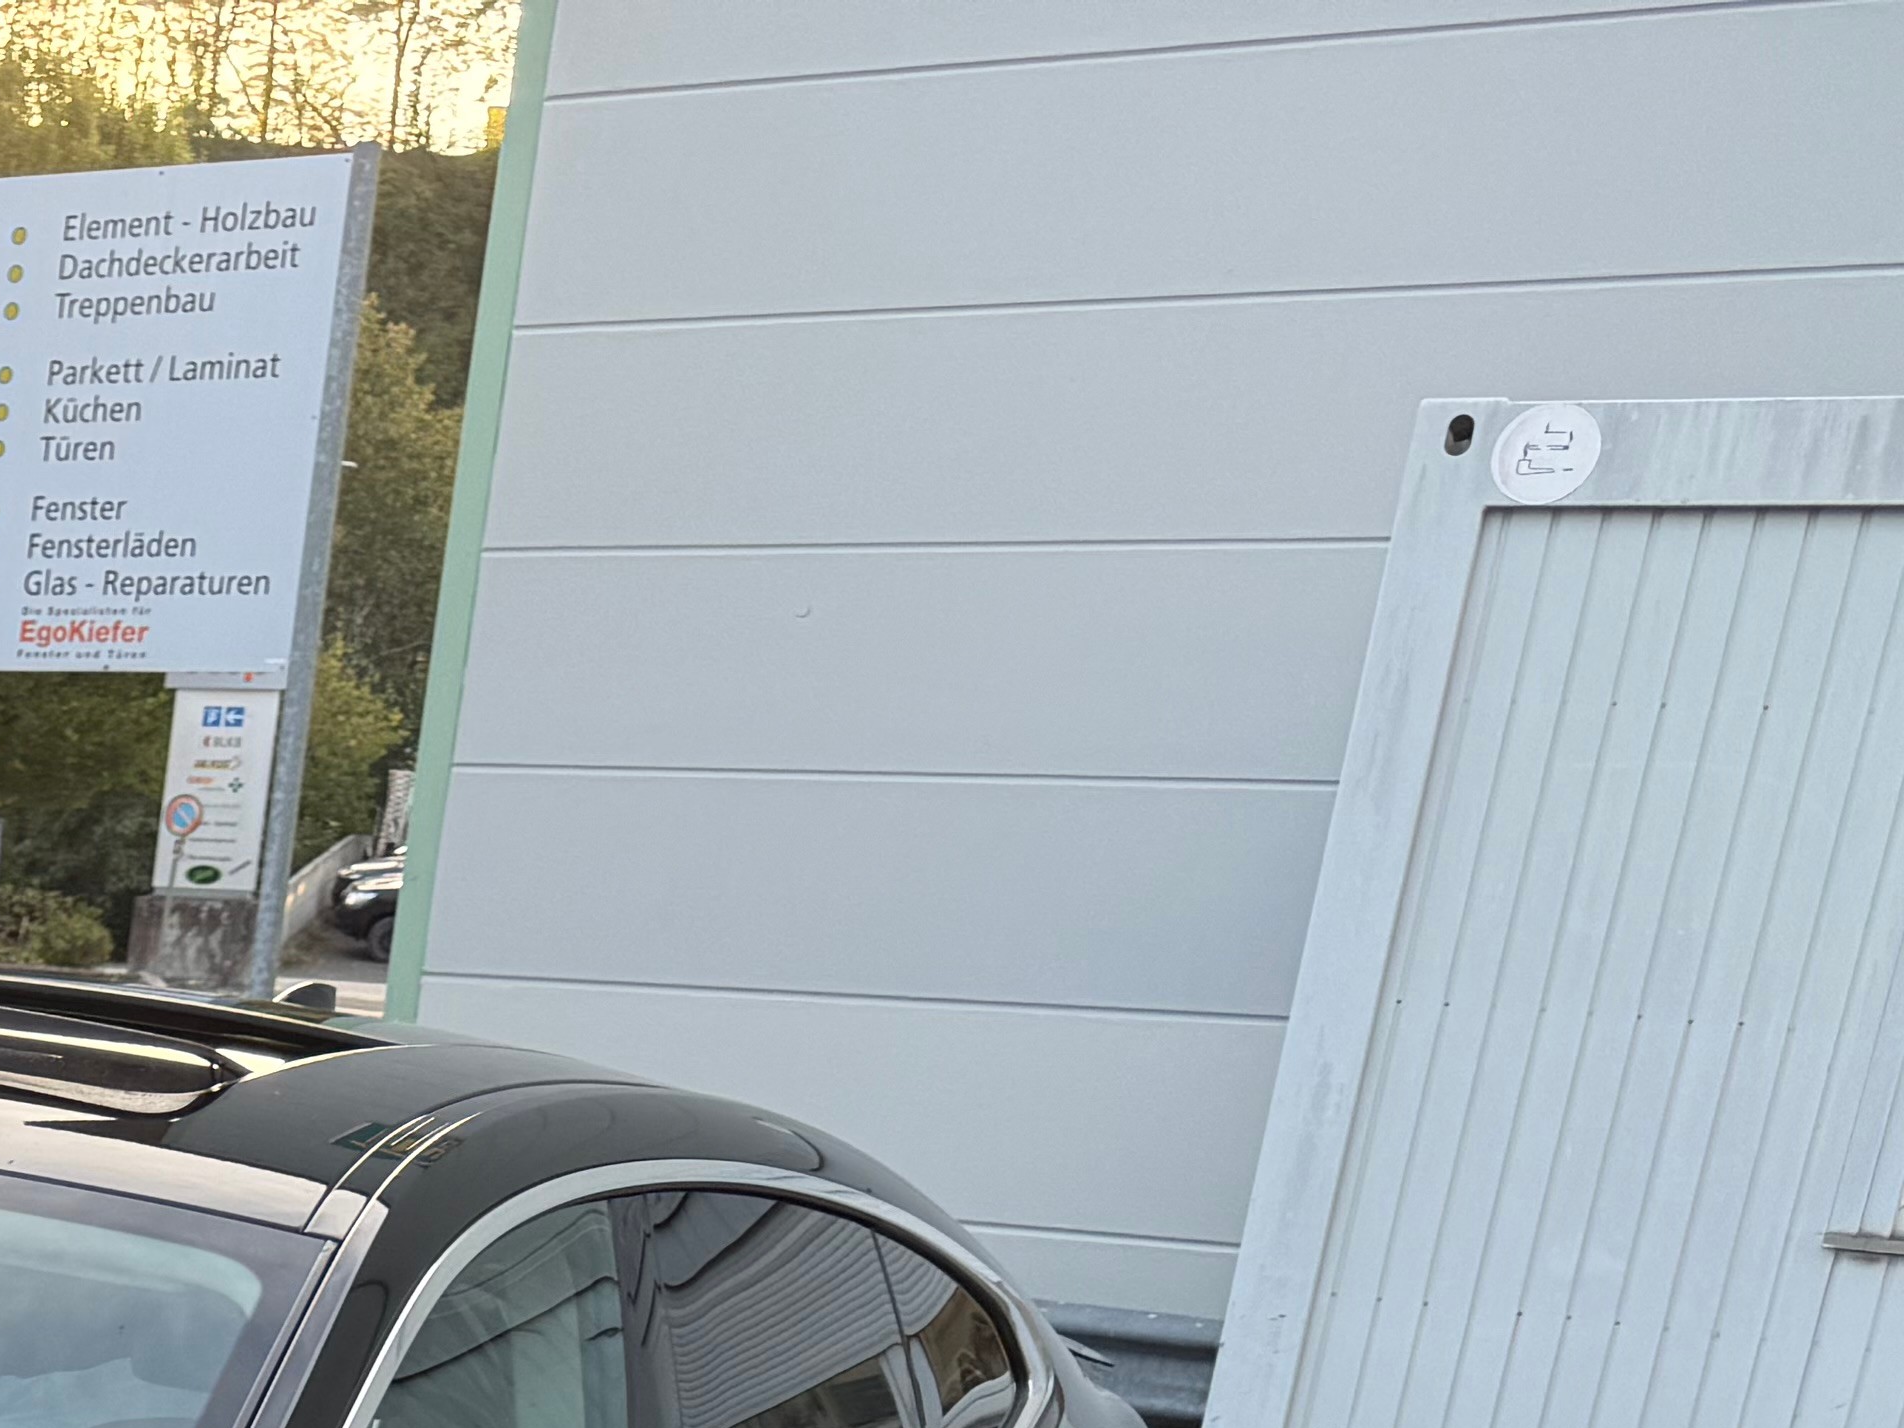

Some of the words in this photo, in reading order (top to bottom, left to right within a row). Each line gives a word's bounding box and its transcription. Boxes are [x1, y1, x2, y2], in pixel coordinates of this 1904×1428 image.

[62, 211, 174, 242] Element
[199, 201, 317, 233] Holzbau
[58, 240, 301, 281] Dachdeckerarbeit
[54, 286, 216, 324] Treppenbau
[46, 356, 144, 386] Parkett
[168, 352, 282, 382] Laminat
[42, 395, 142, 424] Küchen
[40, 436, 116, 462] Türen
[30, 495, 128, 522] Fenster
[26, 530, 197, 560] Fensterläden
[23, 568, 78, 596] Glas
[101, 569, 272, 602] Reparaturen
[19, 619, 150, 648] EgoKiefer
